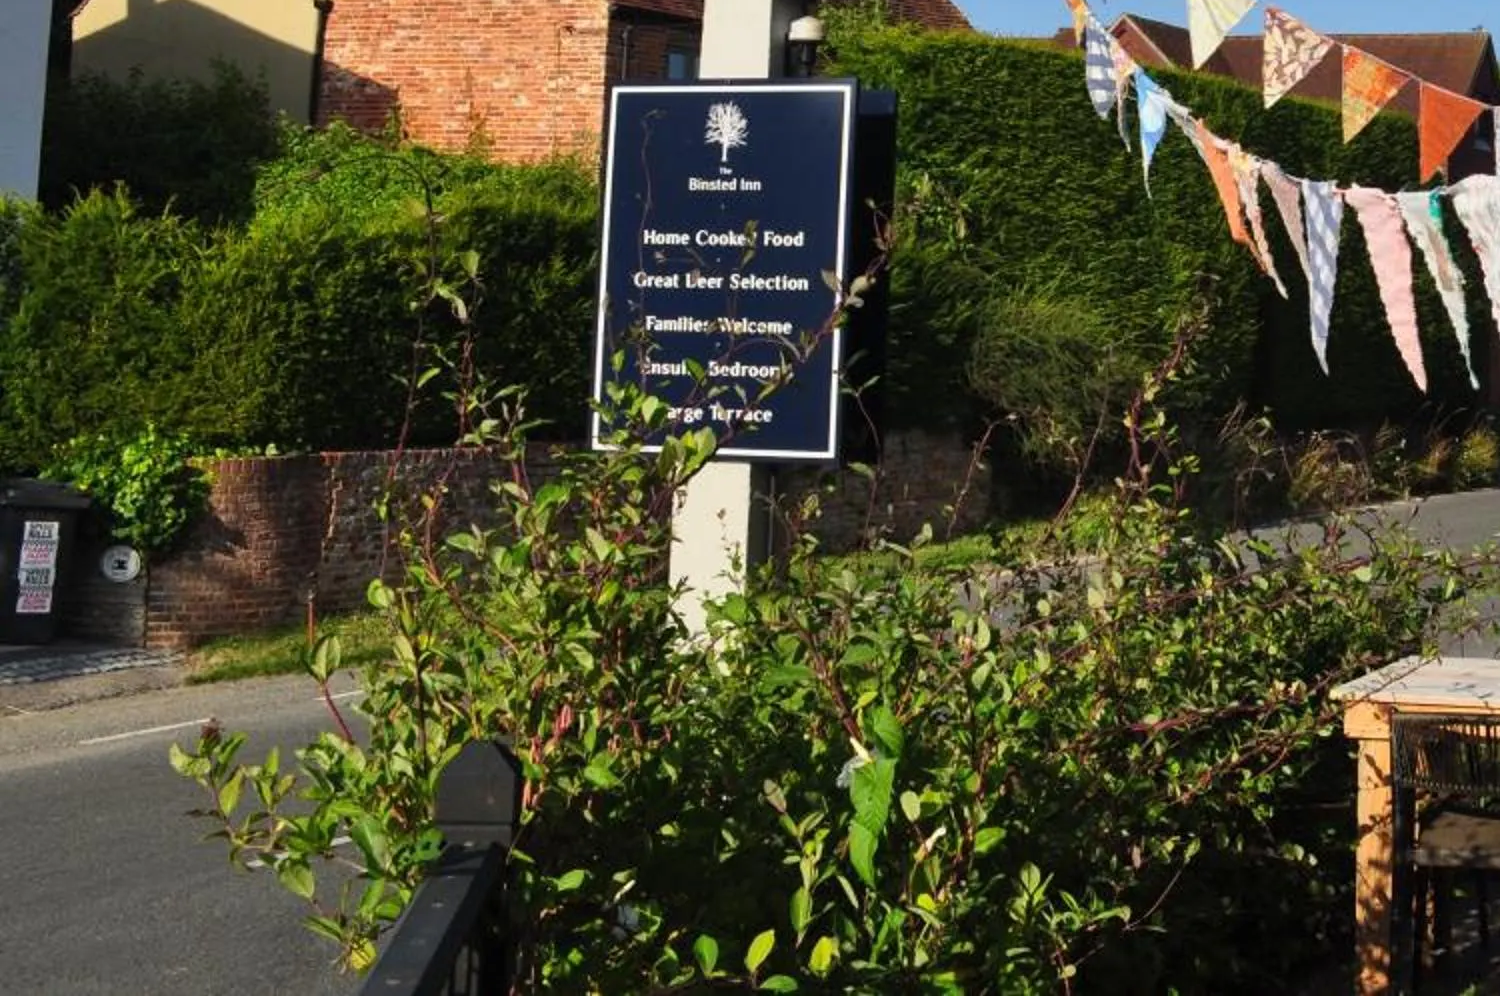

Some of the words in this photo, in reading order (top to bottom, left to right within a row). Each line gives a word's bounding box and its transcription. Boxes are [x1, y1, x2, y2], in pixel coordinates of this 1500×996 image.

[719, 167, 733, 175] The
[688, 177, 738, 191] Binsted
[740, 177, 762, 191] Inn
[643, 229, 691, 246] Home
[763, 230, 805, 247] Food
[633, 270, 680, 289] Great
[729, 273, 809, 291] Selection
[717, 316, 793, 336] Welcome
[641, 359, 702, 377] nsui
[708, 359, 794, 378] Bedroo
[660, 406, 704, 424] arge
